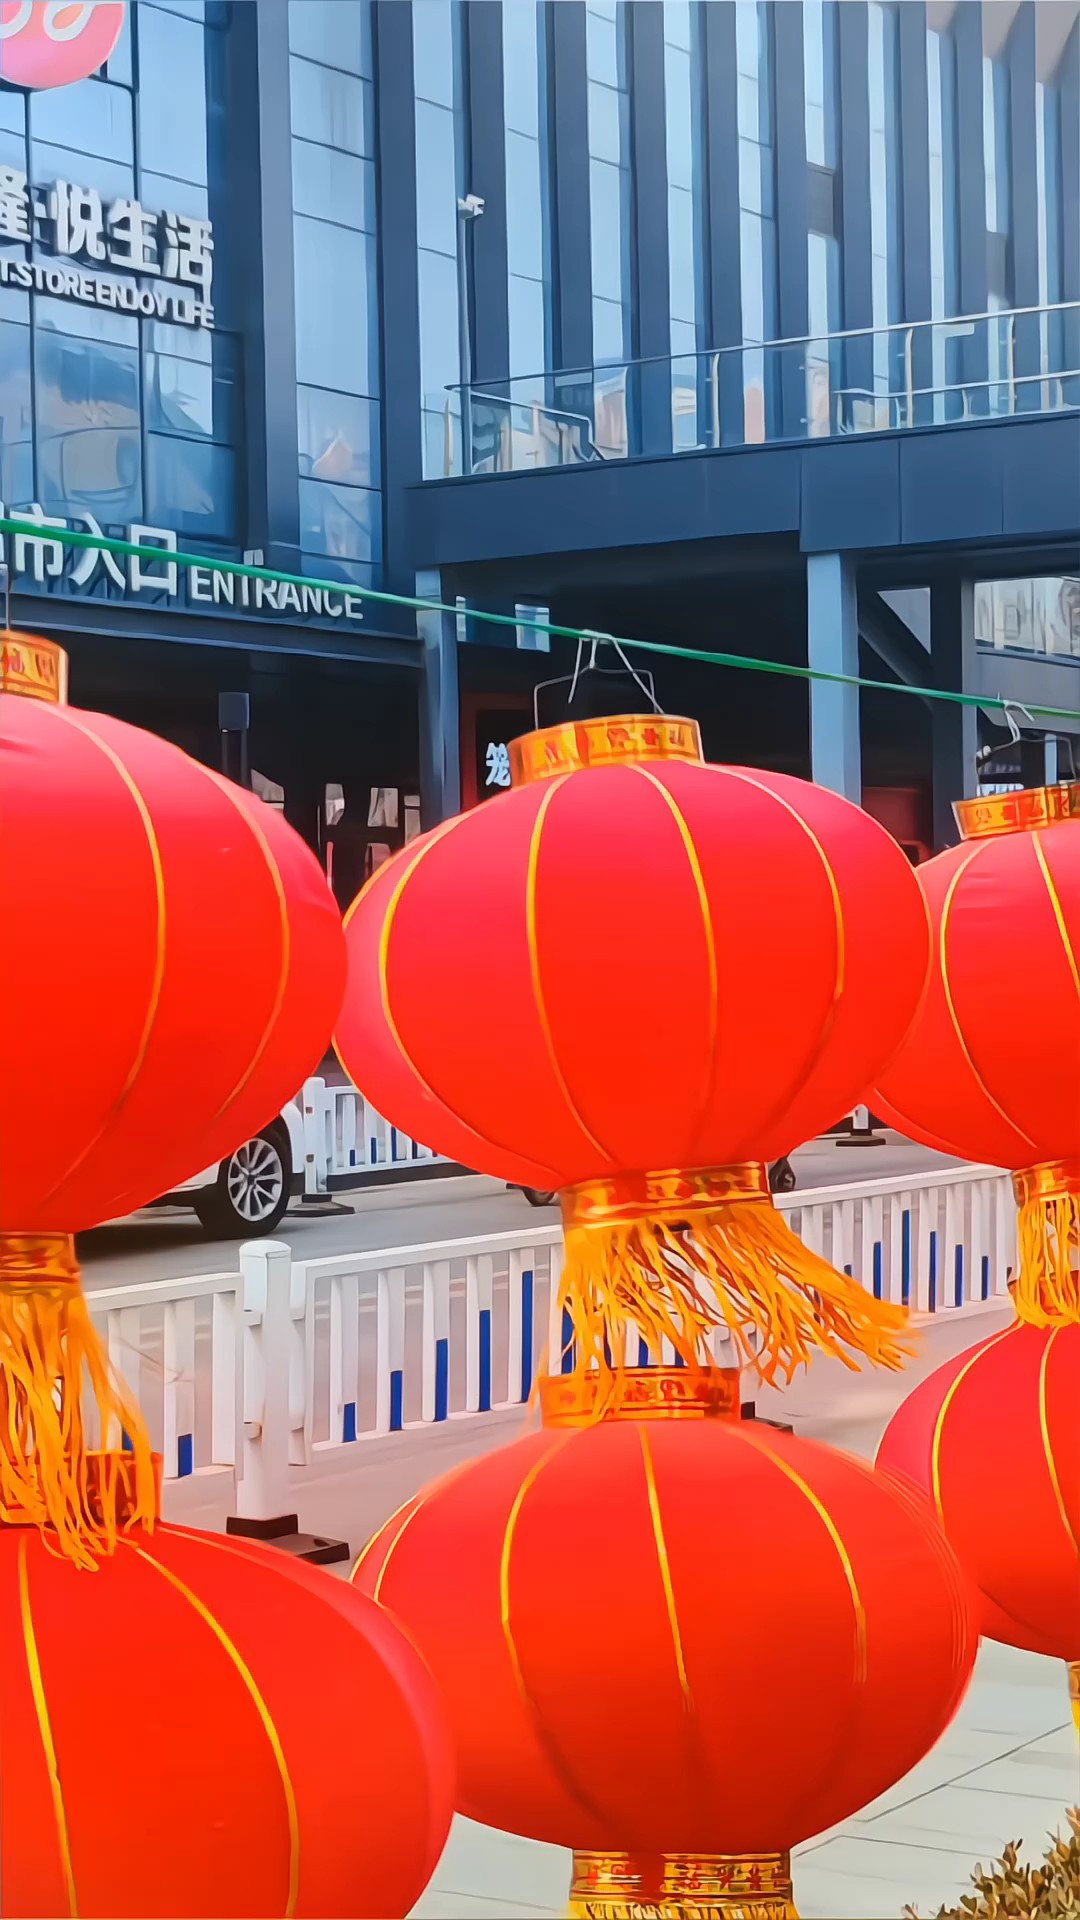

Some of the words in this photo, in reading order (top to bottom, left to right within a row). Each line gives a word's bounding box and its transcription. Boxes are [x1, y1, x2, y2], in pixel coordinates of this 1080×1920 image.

[0, 502, 177, 597] 市入口
[190, 564, 364, 620] ENTRANCE
